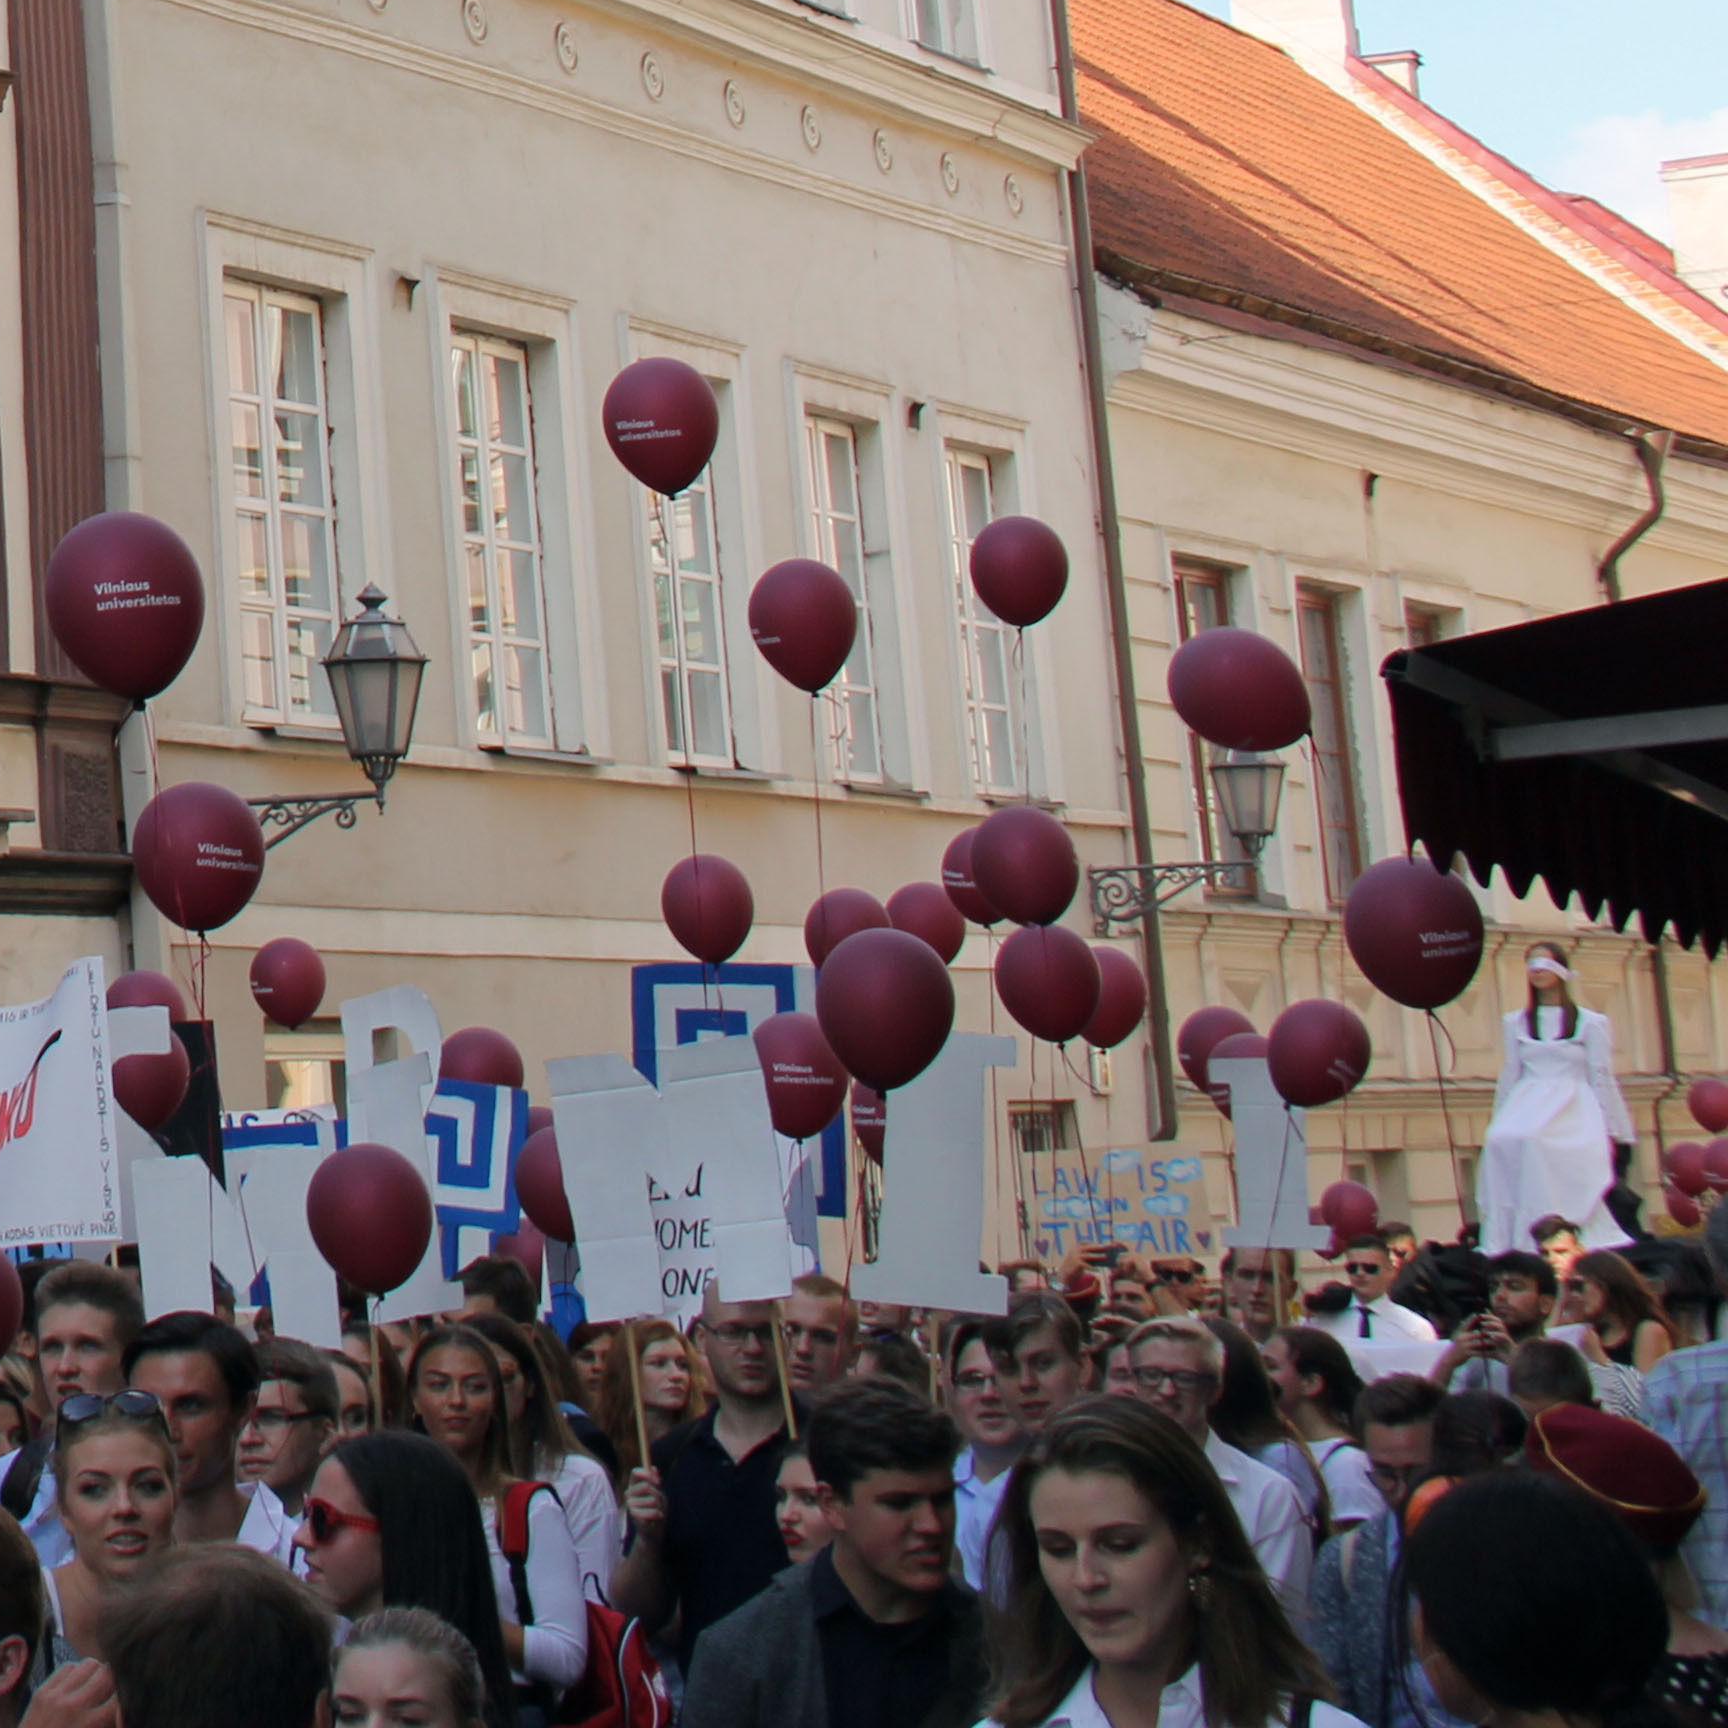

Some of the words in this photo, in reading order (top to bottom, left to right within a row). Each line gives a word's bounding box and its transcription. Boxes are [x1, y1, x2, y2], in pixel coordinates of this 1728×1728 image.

[93, 580, 151, 596] Vilniaus
[96, 595, 182, 612] universitetas
[196, 842, 244, 857] Vilniaus
[1031, 1168, 1100, 1195] LAW
[1136, 1160, 1169, 1193] IS
[1134, 1219, 1193, 1254] AIR
